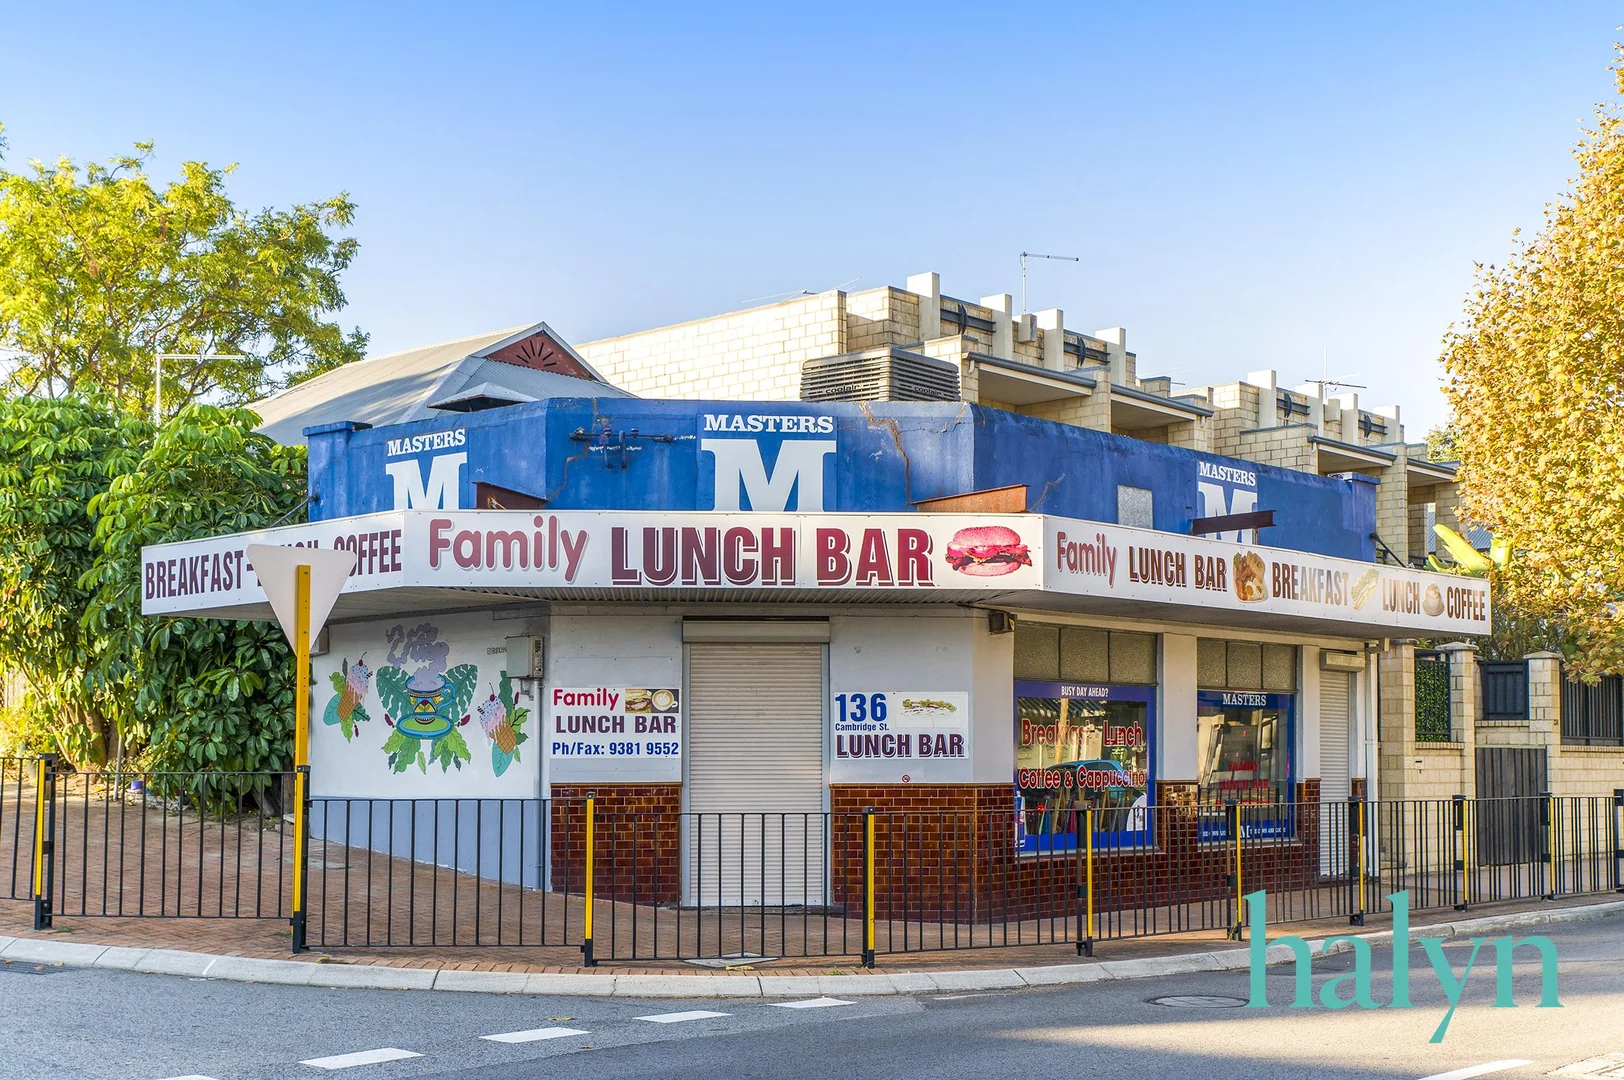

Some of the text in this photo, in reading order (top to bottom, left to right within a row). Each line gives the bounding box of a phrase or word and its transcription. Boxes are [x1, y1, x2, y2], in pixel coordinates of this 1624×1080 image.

[825, 383, 860, 394] coolair
[703, 414, 834, 434] MASTERS
[387, 428, 467, 457] MASTERS
[701, 439, 837, 511] M
[1199, 461, 1256, 487] MASTERS
[429, 515, 935, 588] Family LUNCH BAR
[1056, 531, 1487, 622] Family LUNCH BAR BREAKFAST LUNCH COFFEE
[552, 687, 620, 711] Family
[1061, 685, 1109, 698] BUSY DAY AHEAD?
[1222, 693, 1267, 707] MASTERS
[835, 693, 887, 722] 136
[555, 715, 677, 733] LUNCH BAR
[835, 722, 890, 732] Cambridge St.
[1103, 719, 1143, 747] Lunch
[552, 742, 679, 756] Ph/Fax: 9381 9552
[836, 733, 965, 759] LUNCH BAR
[1018, 765, 1145, 793] Coffee & Cappuccino
